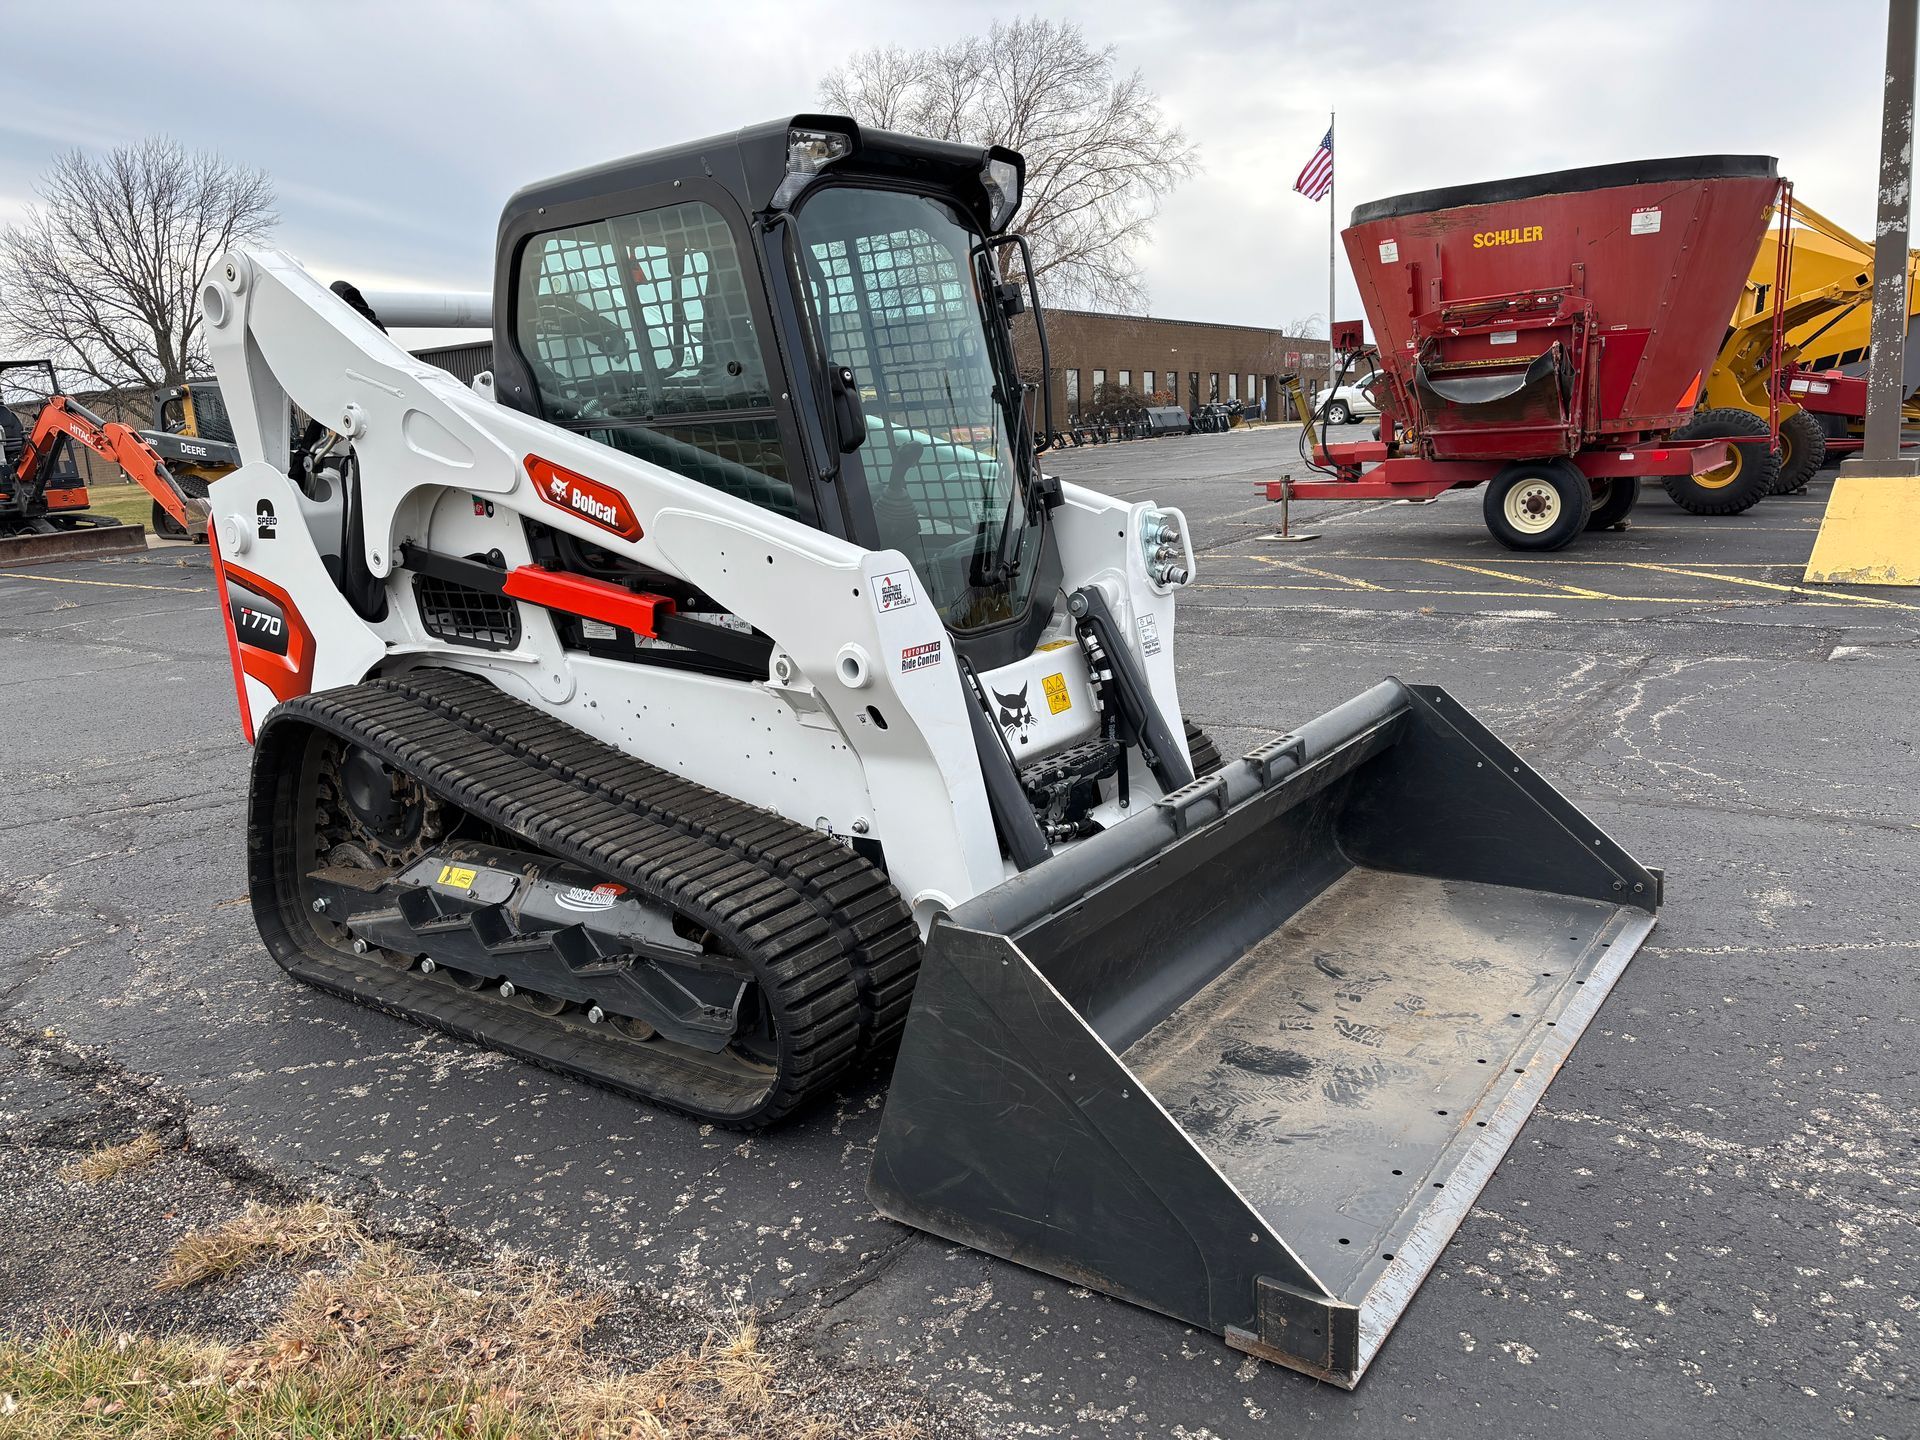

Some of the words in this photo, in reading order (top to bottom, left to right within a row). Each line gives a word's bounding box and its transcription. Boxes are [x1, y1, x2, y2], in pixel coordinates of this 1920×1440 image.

[1472, 225, 1543, 249] SCHULER
[180, 442, 207, 457] DEERE
[571, 487, 617, 526] Bobcat
[256, 498, 277, 539] 2
[257, 516, 278, 526] SPEED
[241, 607, 282, 636] T770
[903, 643, 940, 658] AUTOMATIC
[902, 656, 917, 671] Ride
[917, 651, 941, 667] Control
[567, 887, 617, 905] SUSPENSION
